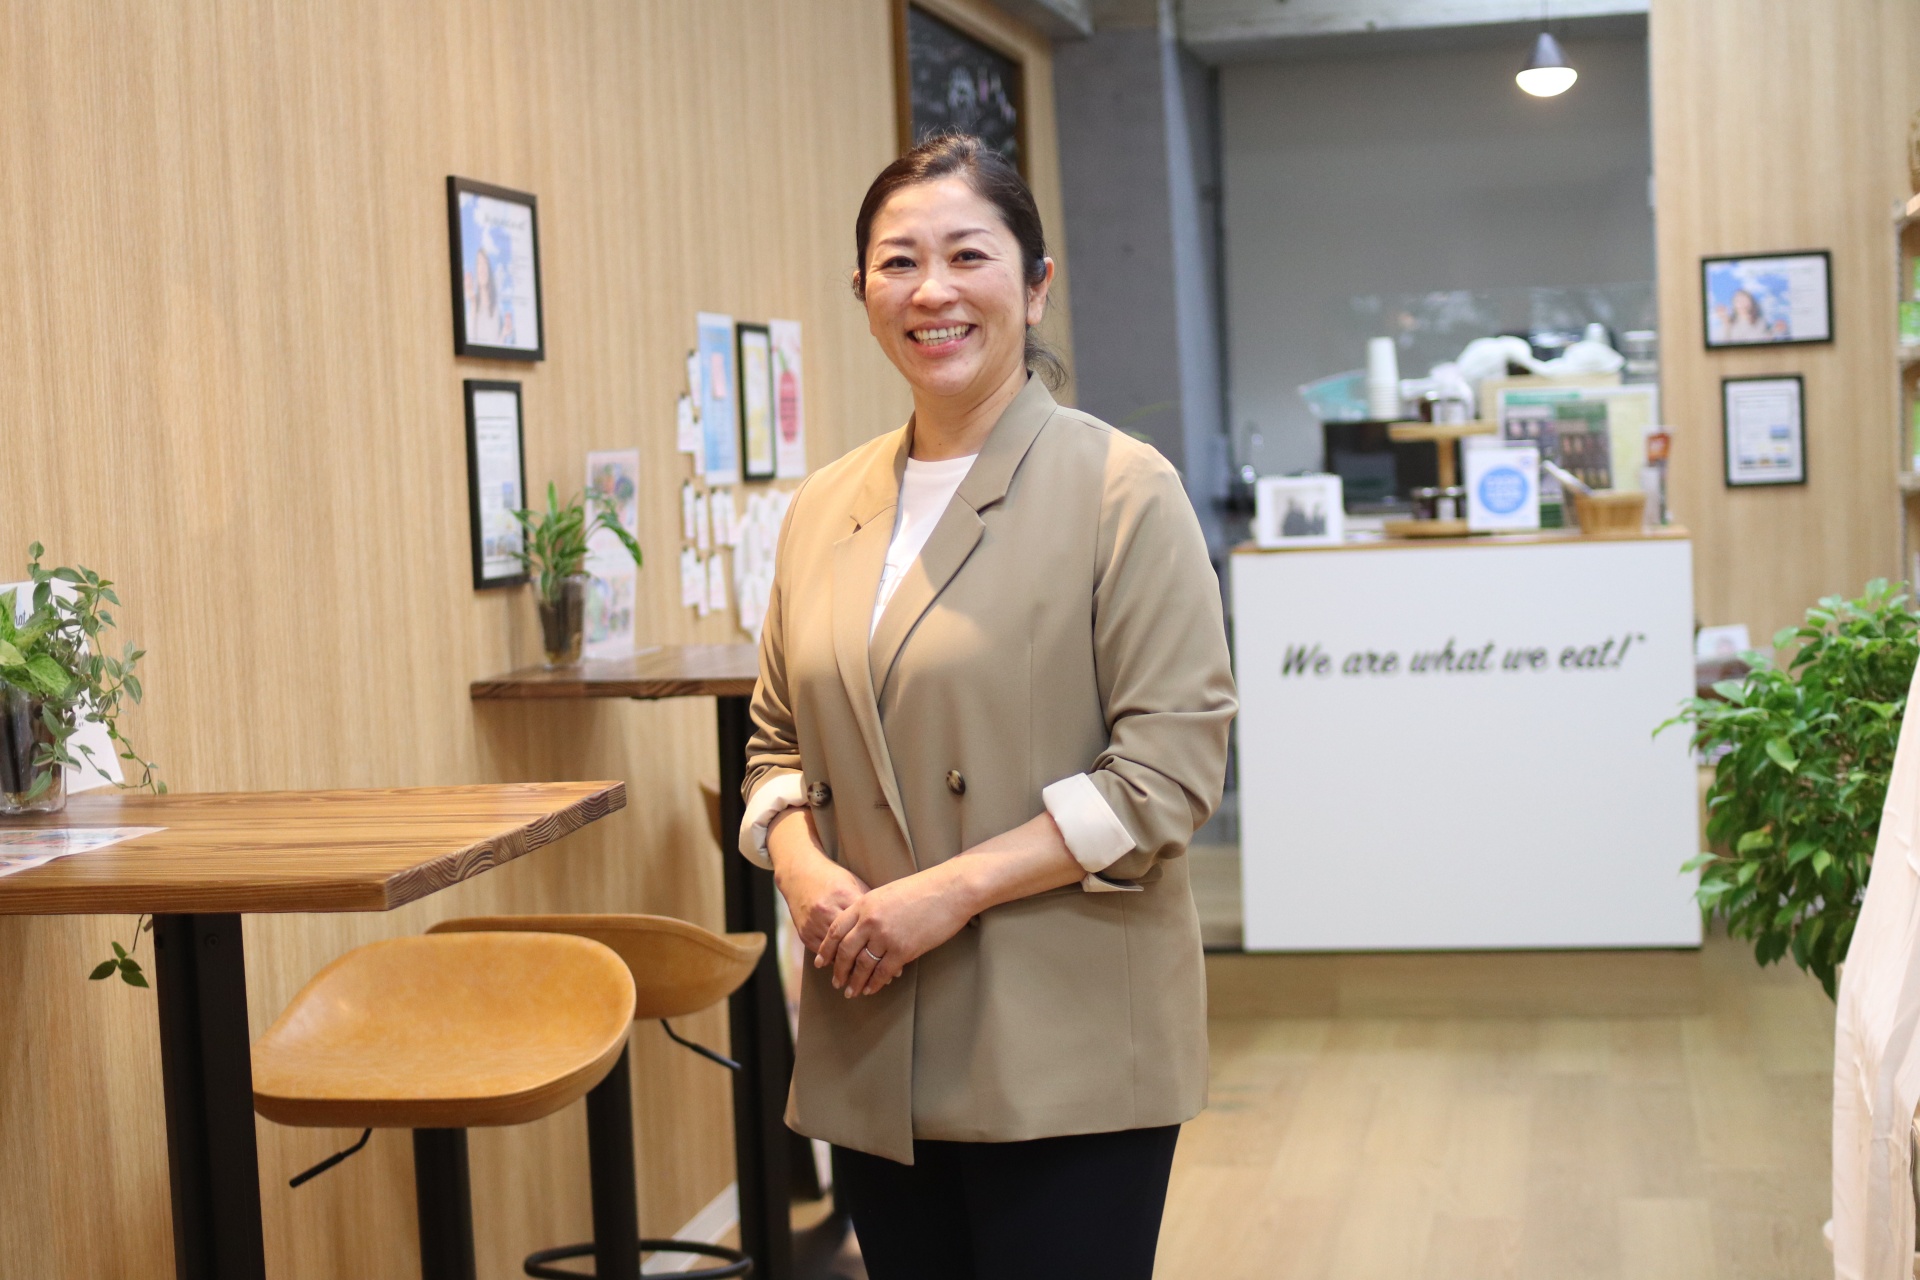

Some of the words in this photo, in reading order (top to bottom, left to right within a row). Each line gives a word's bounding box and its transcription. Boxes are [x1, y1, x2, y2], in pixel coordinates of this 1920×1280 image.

[1281, 643, 1332, 677] We
[1341, 651, 1400, 676] are
[1408, 637, 1496, 674] what
[1501, 647, 1549, 672] we
